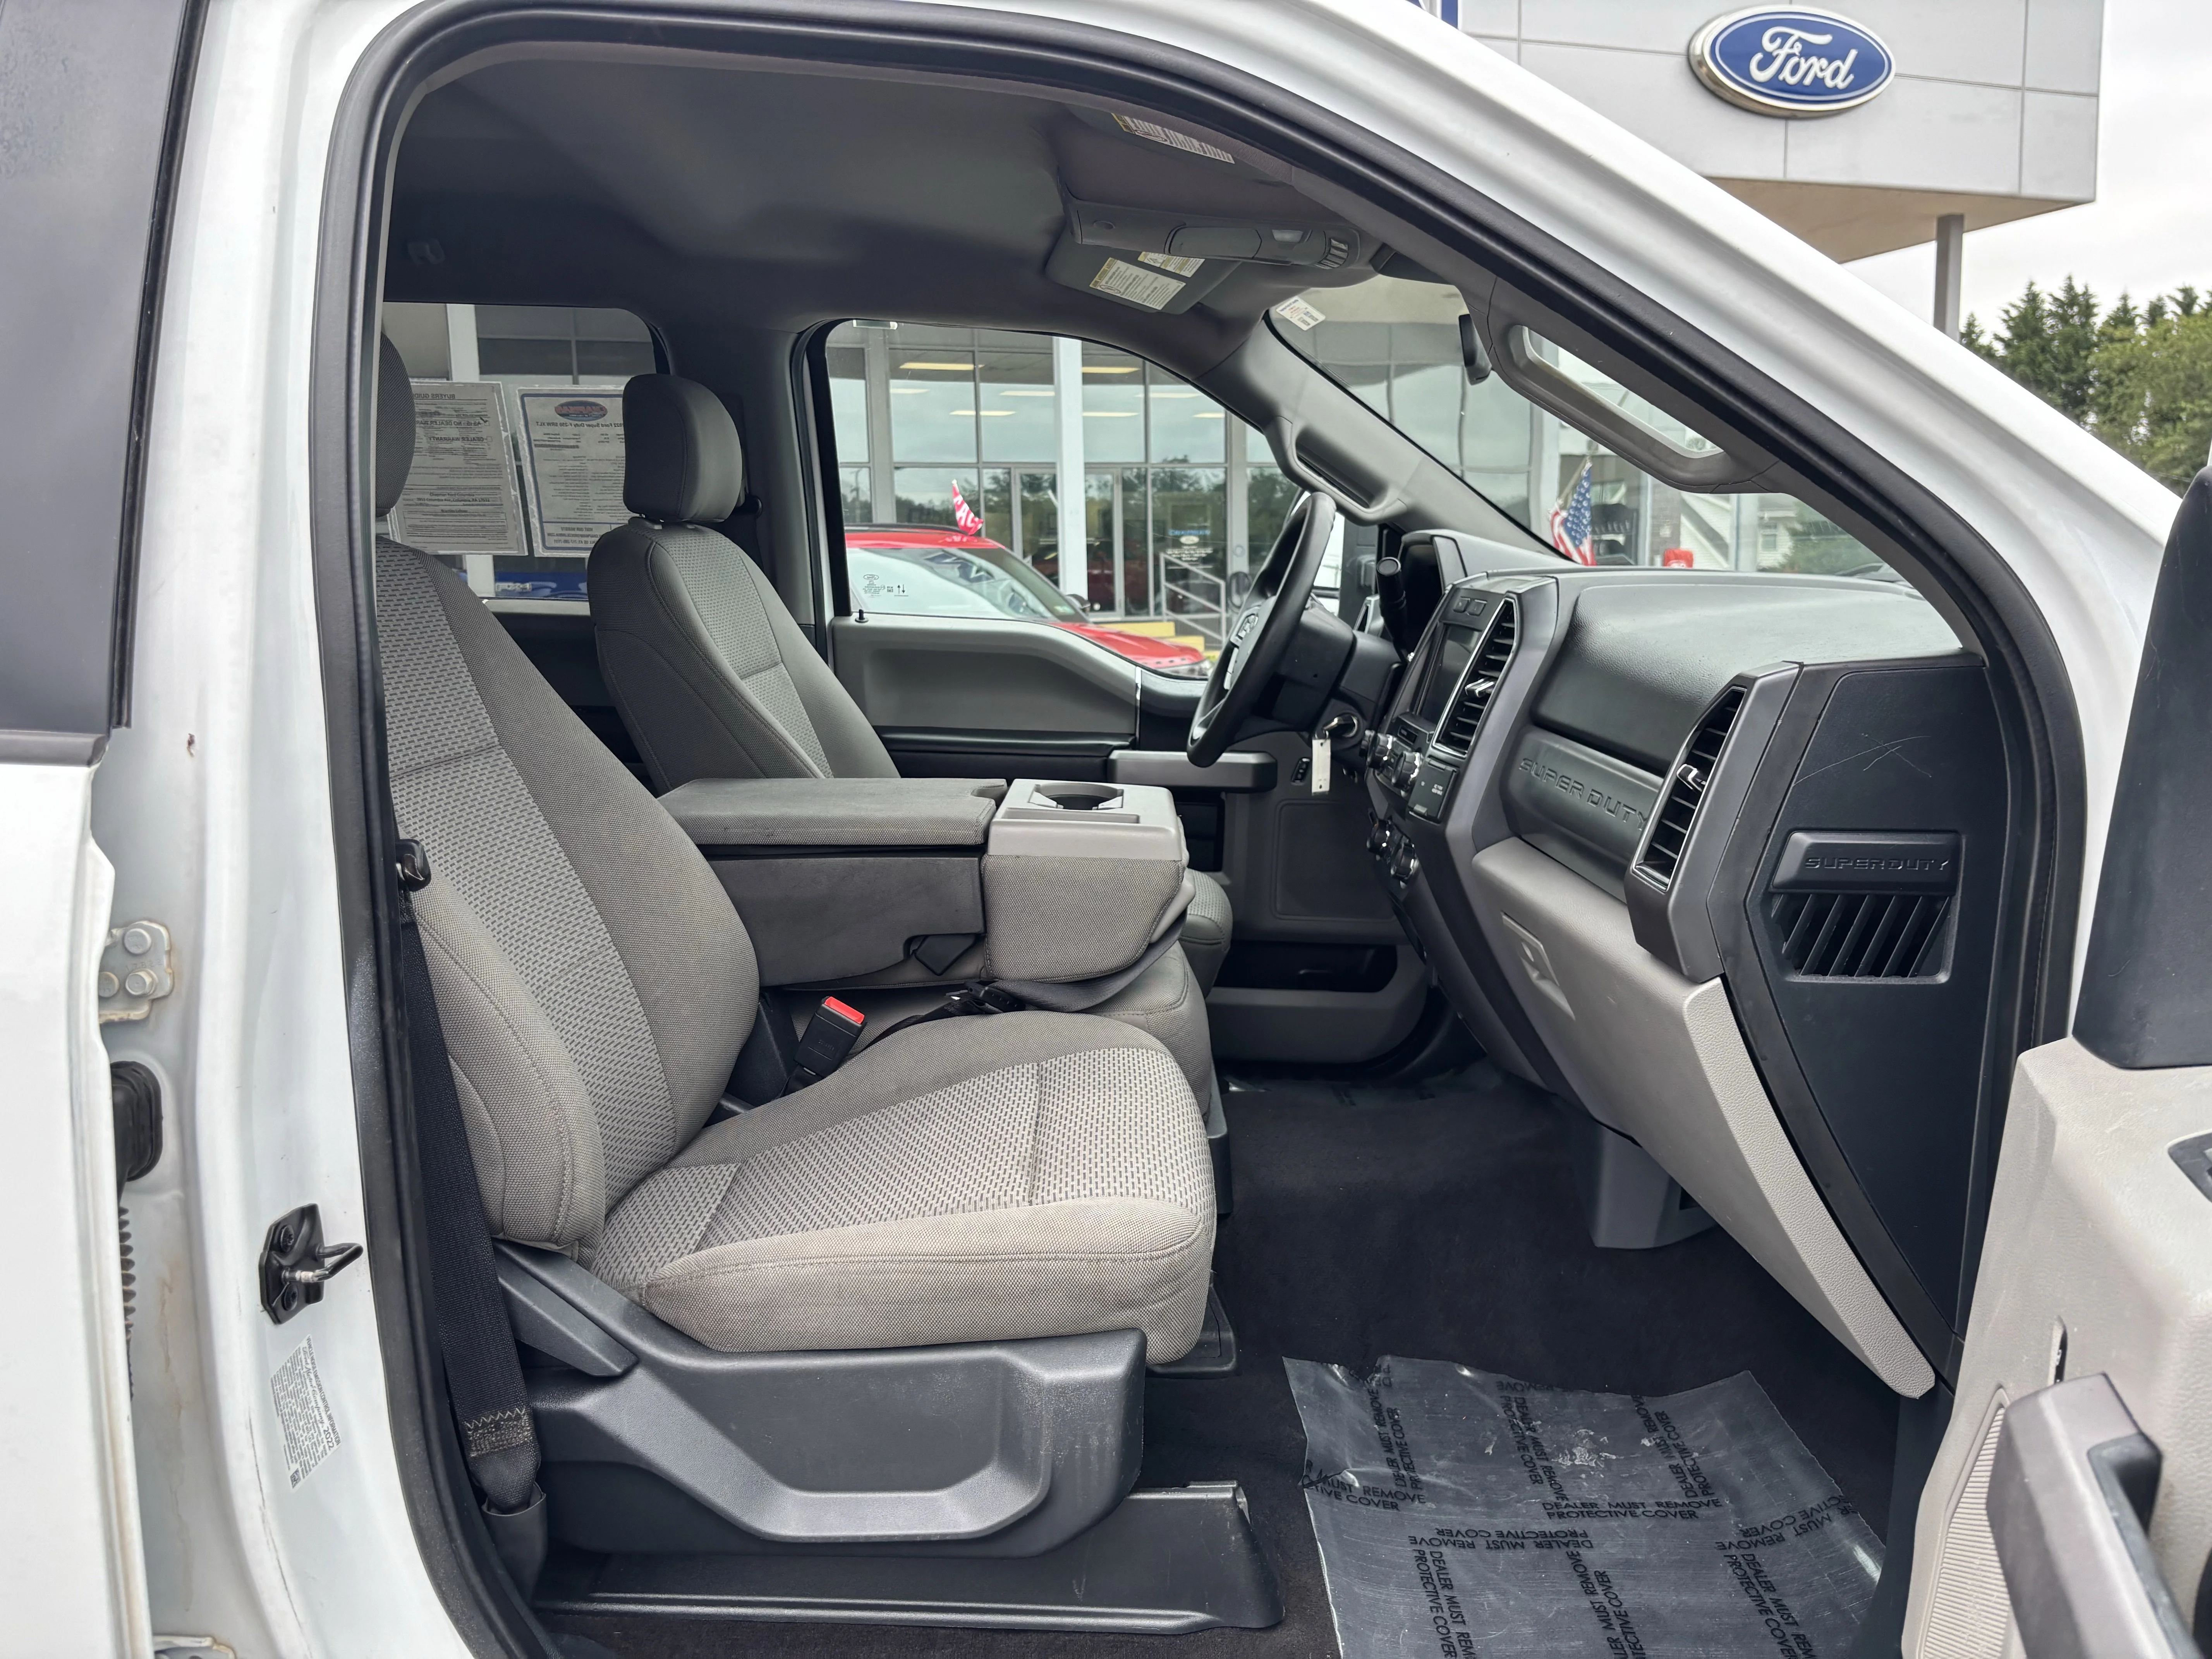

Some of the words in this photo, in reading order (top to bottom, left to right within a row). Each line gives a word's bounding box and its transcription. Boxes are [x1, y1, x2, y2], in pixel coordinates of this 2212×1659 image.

[1749, 26, 1858, 90] Ford
[1518, 757, 1585, 800] SUPER
[1586, 789, 1647, 831] DUTY
[1805, 857, 1885, 869] SUPER
[1888, 859, 1950, 870] DUTY
[319, 1391, 330, 1415] CONTROL
[327, 1412, 341, 1446] INFORMATION
[1387, 1407, 1405, 1439] COVER
[1654, 1410, 1680, 1441] COVER
[323, 1426, 334, 1451] 2022
[1378, 1432, 1394, 1455] MUST
[1521, 1453, 1544, 1485] COVER
[1529, 1435, 1549, 1461] MUST
[1540, 1465, 1569, 1502] REMOVE
[1669, 1463, 1698, 1498] DEALER
[1672, 1440, 1715, 1497] PROTECTIVE
[1346, 1494, 1400, 1511] COVER
[1363, 1485, 1427, 1504] REMOVE
[1542, 1502, 1600, 1510] DEALER
[1655, 1498, 1723, 1510] REMOVE
[1547, 1510, 1639, 1520] PROTECTIVE
[1642, 1510, 1699, 1520] COVER
[1739, 1515, 1796, 1538] COVER
[1793, 1513, 1832, 1536] MUST
[1408, 1535, 1476, 1549] REMOVE
[1435, 1527, 1492, 1537] COVER
[1486, 1539, 1525, 1549] MUST
[1495, 1529, 1589, 1539] PROTECTIVE
[1535, 1539, 1594, 1549] DEALER
[1715, 1532, 1786, 1550] REMOVE
[1413, 1549, 1444, 1613] PROTECTIVE
[1429, 1551, 1454, 1590] DEALER
[1566, 1551, 1599, 1596] REMOVE
[1723, 1554, 1774, 1616] PROTECTIVE
[1594, 1570, 1623, 1607] COVER
[1444, 1594, 1467, 1626] MUST
[1590, 1600, 1616, 1630] MUST
[1741, 1553, 1777, 1594] DEALER
[1769, 1597, 1799, 1627] MUST
[1791, 1633, 1819, 1659] REM
[1455, 1631, 1477, 1659] REM
[1613, 1610, 1646, 1659] TECTIVE
